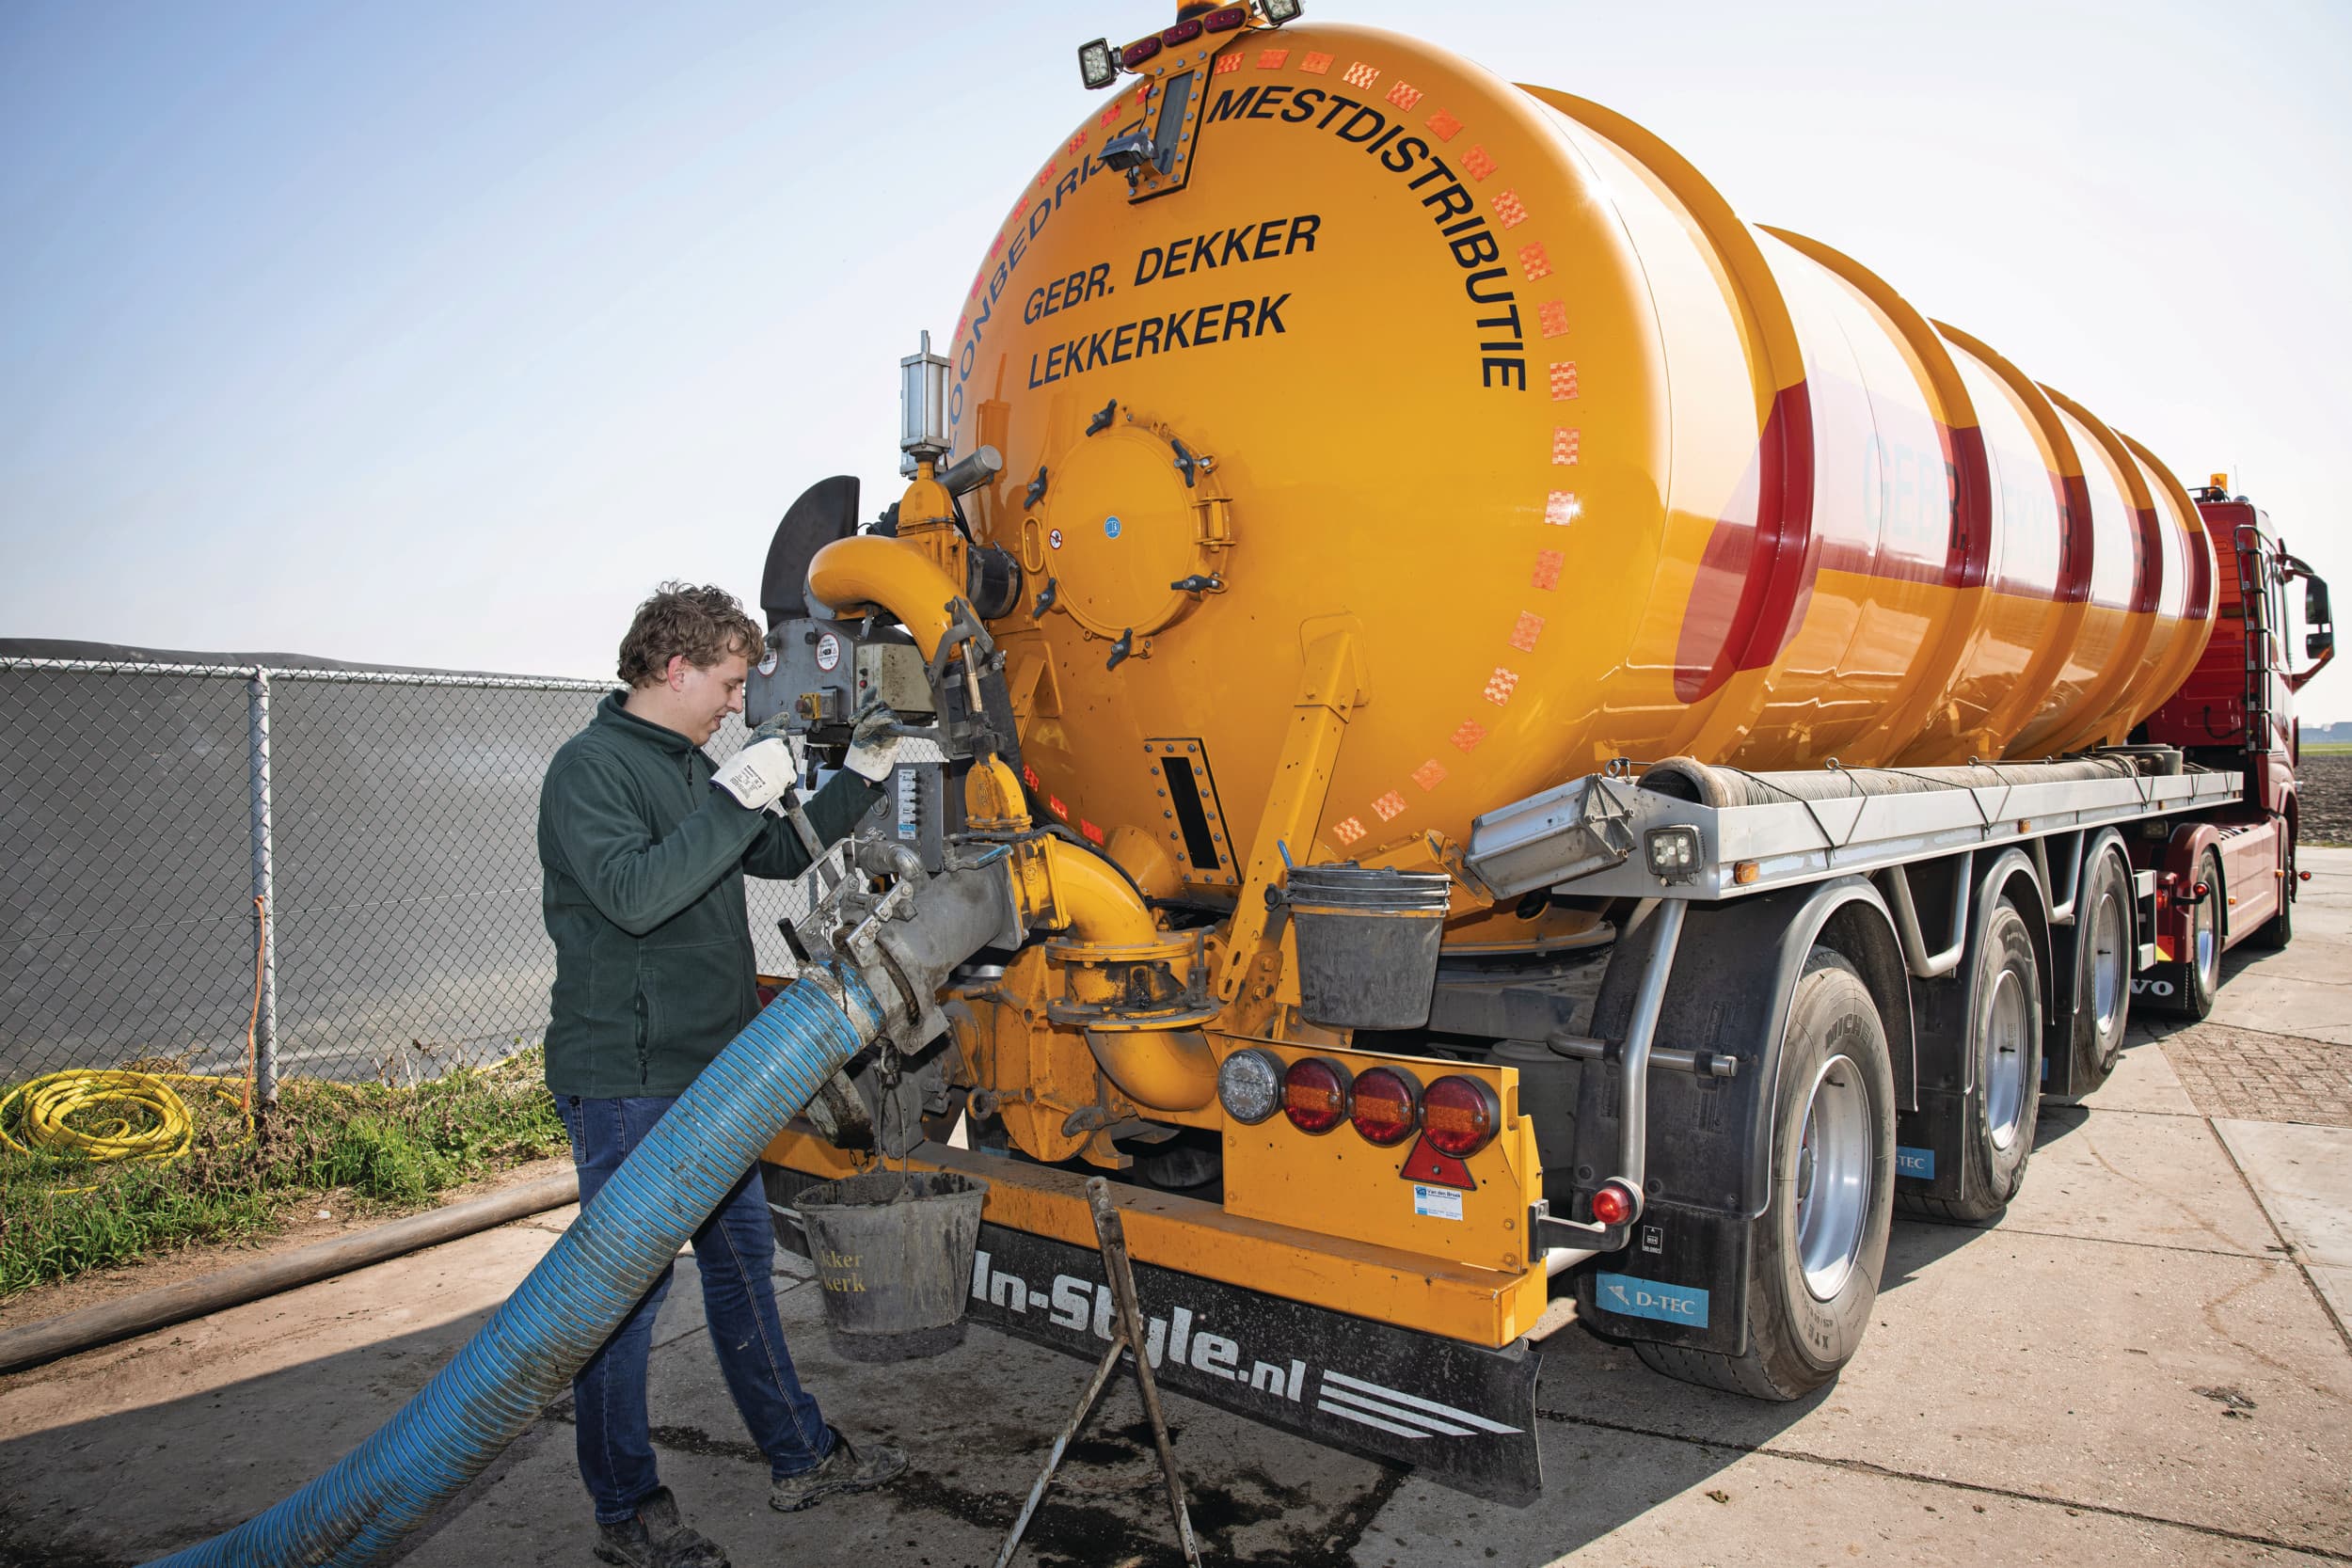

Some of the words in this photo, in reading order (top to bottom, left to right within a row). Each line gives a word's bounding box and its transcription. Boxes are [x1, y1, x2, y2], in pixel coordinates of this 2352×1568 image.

[1206, 86, 1526, 391] MESTDISTRIBUTIE
[1025, 262, 1114, 325] GEBR.
[1134, 214, 1321, 286] DEKKER
[1028, 293, 1292, 389] LEKKERKERK
[2130, 978, 2174, 996] VO
[1896, 1155, 1925, 1169] -TEC
[819, 1250, 864, 1268] kker
[822, 1273, 866, 1292] kerk
[1637, 1291, 1695, 1315] D-TEC
[972, 1250, 1306, 1402] In-Style.nl
